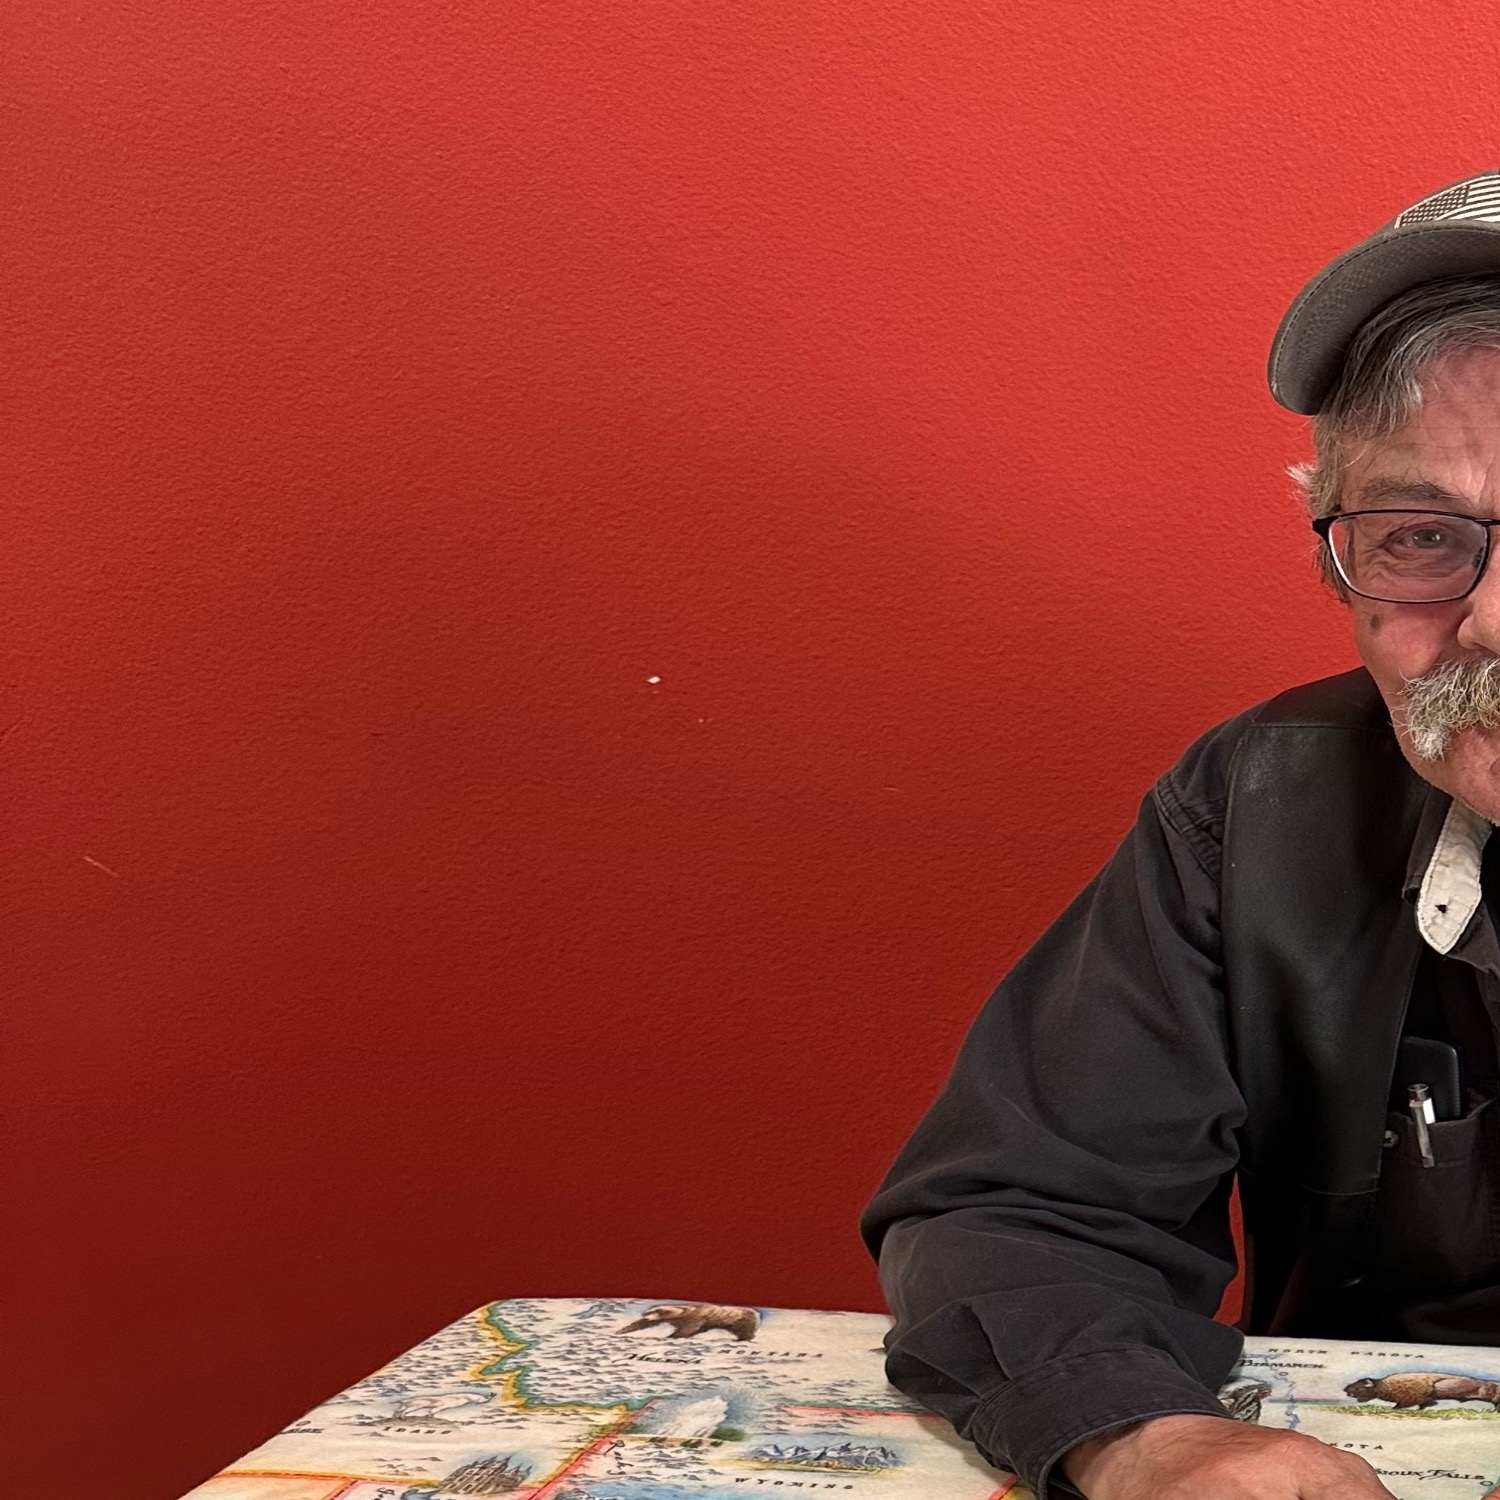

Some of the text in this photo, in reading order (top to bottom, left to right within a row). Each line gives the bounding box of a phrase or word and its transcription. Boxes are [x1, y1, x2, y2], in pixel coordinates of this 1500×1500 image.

[717, 1349, 824, 1359] MONTANA
[384, 1426, 453, 1435] IDAHO
[1329, 1442, 1384, 1450] KOTA
[734, 1477, 854, 1490] WYOMING
